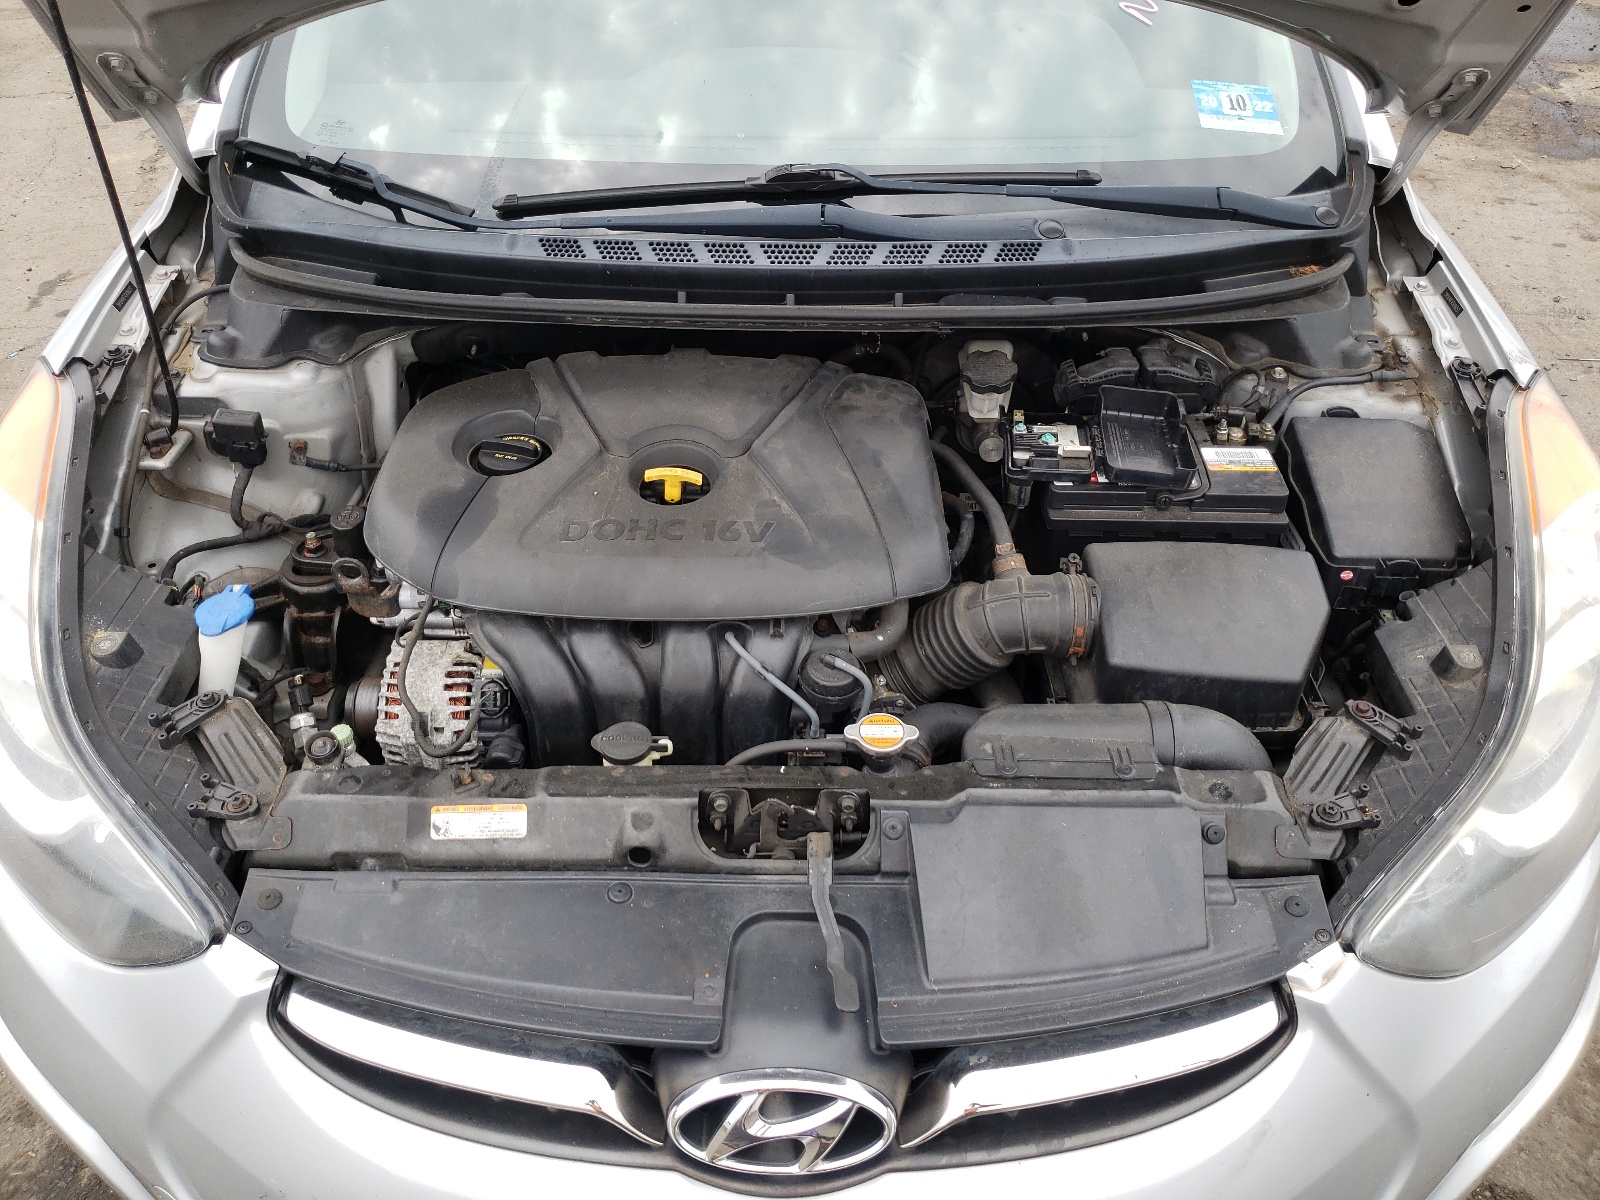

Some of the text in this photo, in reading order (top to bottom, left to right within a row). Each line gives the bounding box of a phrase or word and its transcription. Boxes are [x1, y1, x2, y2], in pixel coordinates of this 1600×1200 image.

[1199, 94, 1274, 112] 20 10 22
[559, 518, 776, 542] DOHC 16V
